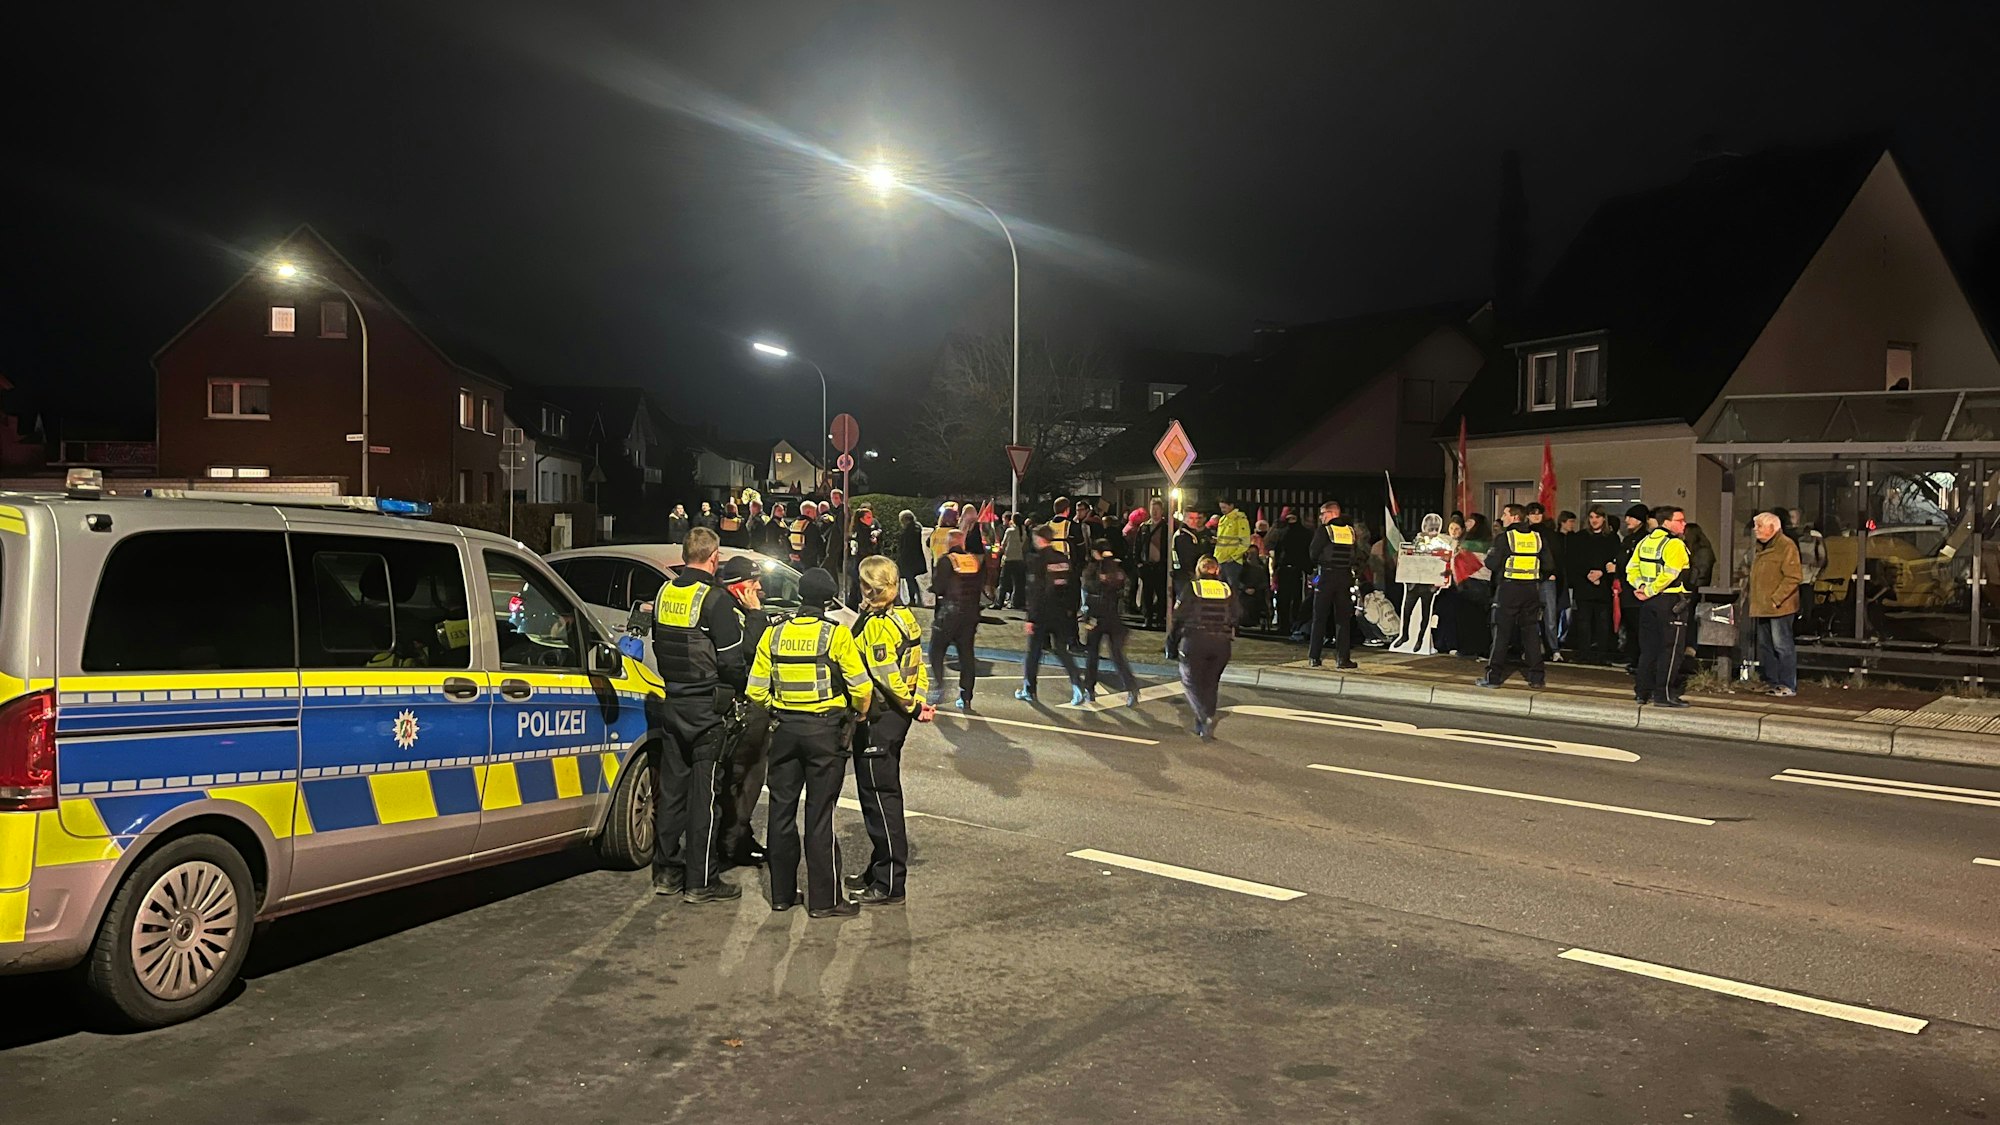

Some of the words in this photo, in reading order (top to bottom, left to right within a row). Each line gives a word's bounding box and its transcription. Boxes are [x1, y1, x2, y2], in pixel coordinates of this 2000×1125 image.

[661, 600, 687, 615] POLIZEI
[780, 639, 816, 652] POLIZEI
[518, 709, 587, 738] POLIZEI
